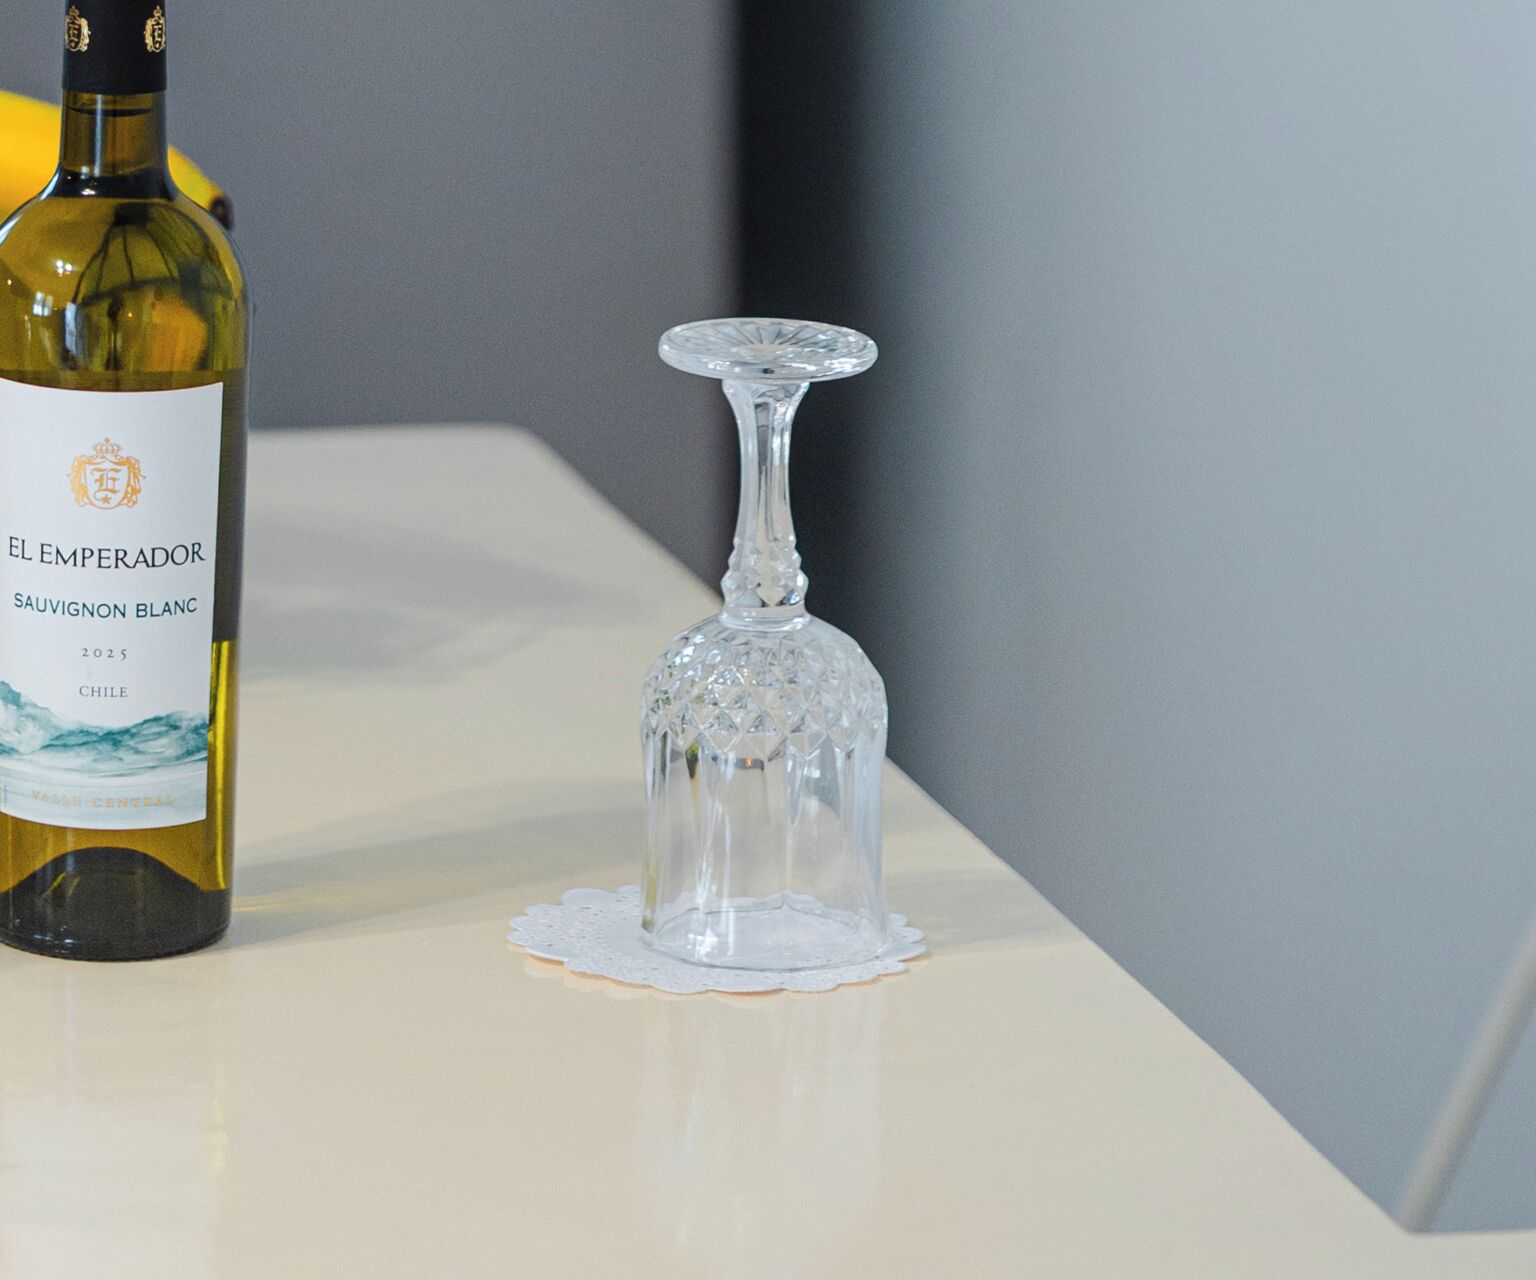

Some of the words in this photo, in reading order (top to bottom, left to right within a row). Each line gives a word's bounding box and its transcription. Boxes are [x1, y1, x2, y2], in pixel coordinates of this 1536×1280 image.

[8, 536, 32, 561] EL
[39, 542, 206, 570] EMPERADOR
[14, 592, 127, 619] SAUVIGNON
[135, 597, 198, 618] BLANC
[81, 647, 128, 662] 2025
[78, 685, 129, 699] CHILE
[31, 789, 82, 808] VALLE
[91, 794, 176, 809] CENTRAL
